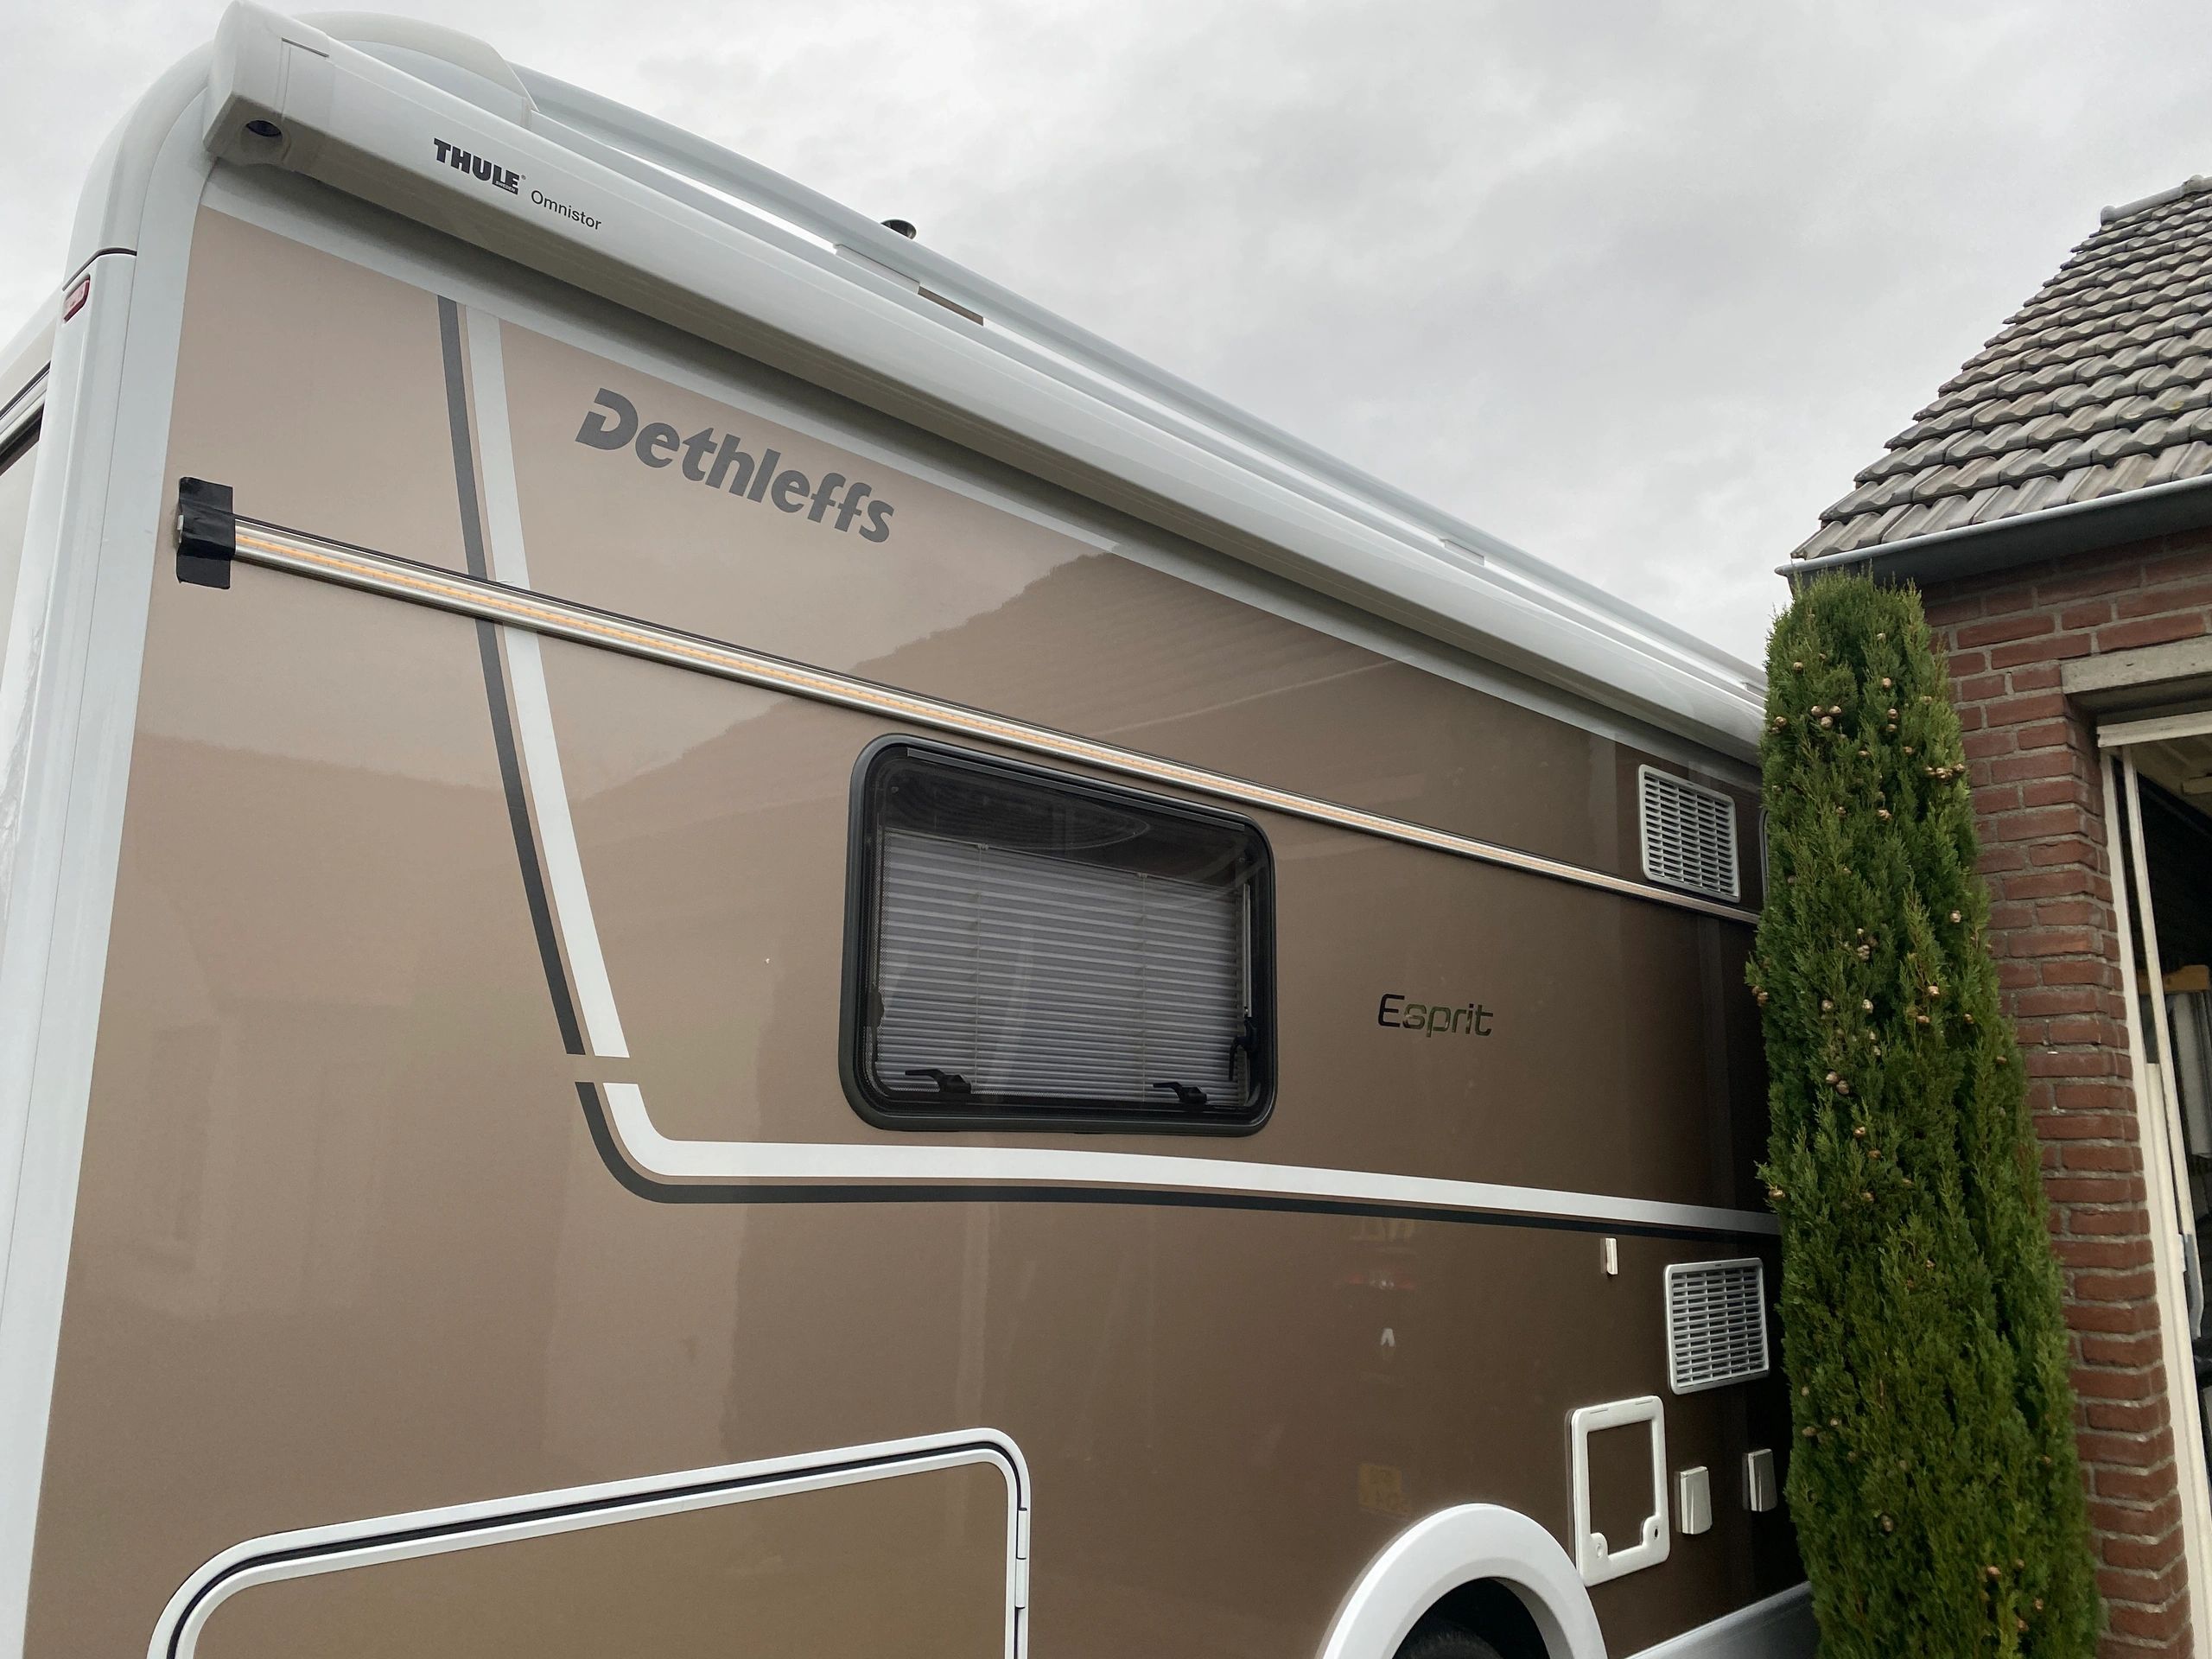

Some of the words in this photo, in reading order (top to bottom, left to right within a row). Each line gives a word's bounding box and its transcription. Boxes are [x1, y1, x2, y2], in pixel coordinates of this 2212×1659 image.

[434, 137, 520, 194] THULE
[531, 190, 602, 231] Omnistor
[575, 387, 894, 543] Dethleffs
[1377, 993, 1494, 1038] Esprit
